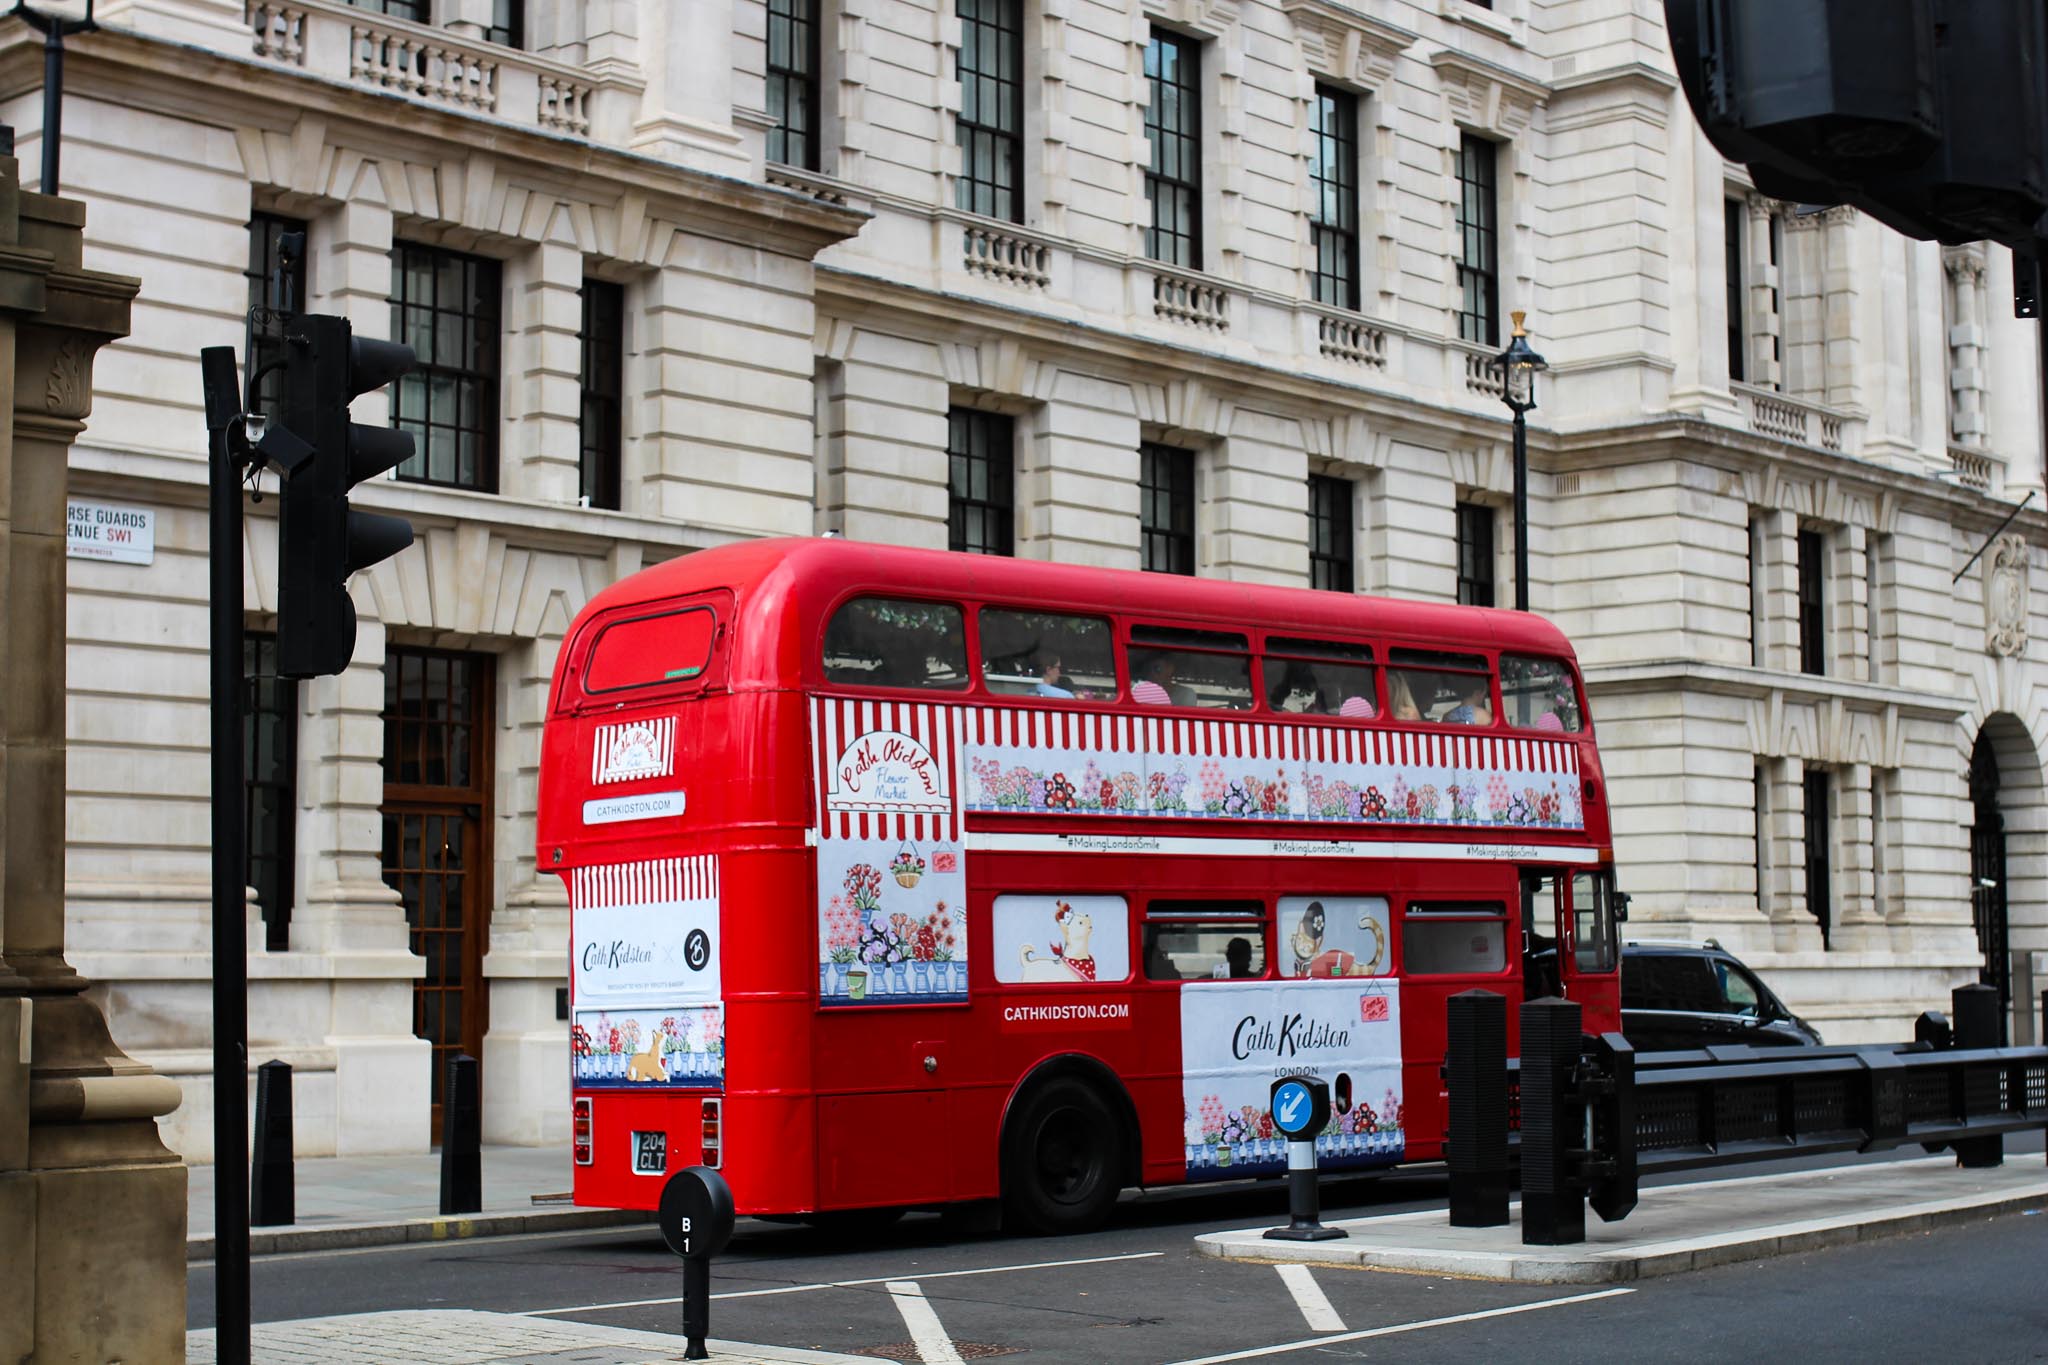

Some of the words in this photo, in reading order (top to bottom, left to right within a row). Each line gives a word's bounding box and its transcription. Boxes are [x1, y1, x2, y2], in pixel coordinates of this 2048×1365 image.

[68, 506, 91, 523] RSE
[96, 508, 146, 529] GUARDS
[67, 523, 100, 540] ENUE
[107, 528, 132, 544] SW1
[841, 738, 880, 792] Cath
[883, 738, 937, 795] Kidston
[876, 766, 909, 784] Flower
[874, 785, 909, 800] Market
[597, 800, 671, 817] CATHKIDSTON.COM
[1068, 836, 1160, 852] #MakingLondonSmile
[1273, 840, 1354, 856] #MakingLondonSmile
[1466, 845, 1538, 860] #MakingLondonSmile
[583, 942, 608, 972] Cath
[608, 940, 652, 969] Kidston
[1004, 1004, 1129, 1021] CATHKIDSTON.COM
[1232, 1015, 1276, 1060] Cath
[1277, 1013, 1351, 1058] Kidston
[1274, 1066, 1319, 1077] LONDON
[641, 1134, 666, 1150] 204
[640, 1152, 665, 1169] CLT
[682, 1217, 691, 1232] B
[683, 1237, 690, 1253] 1
